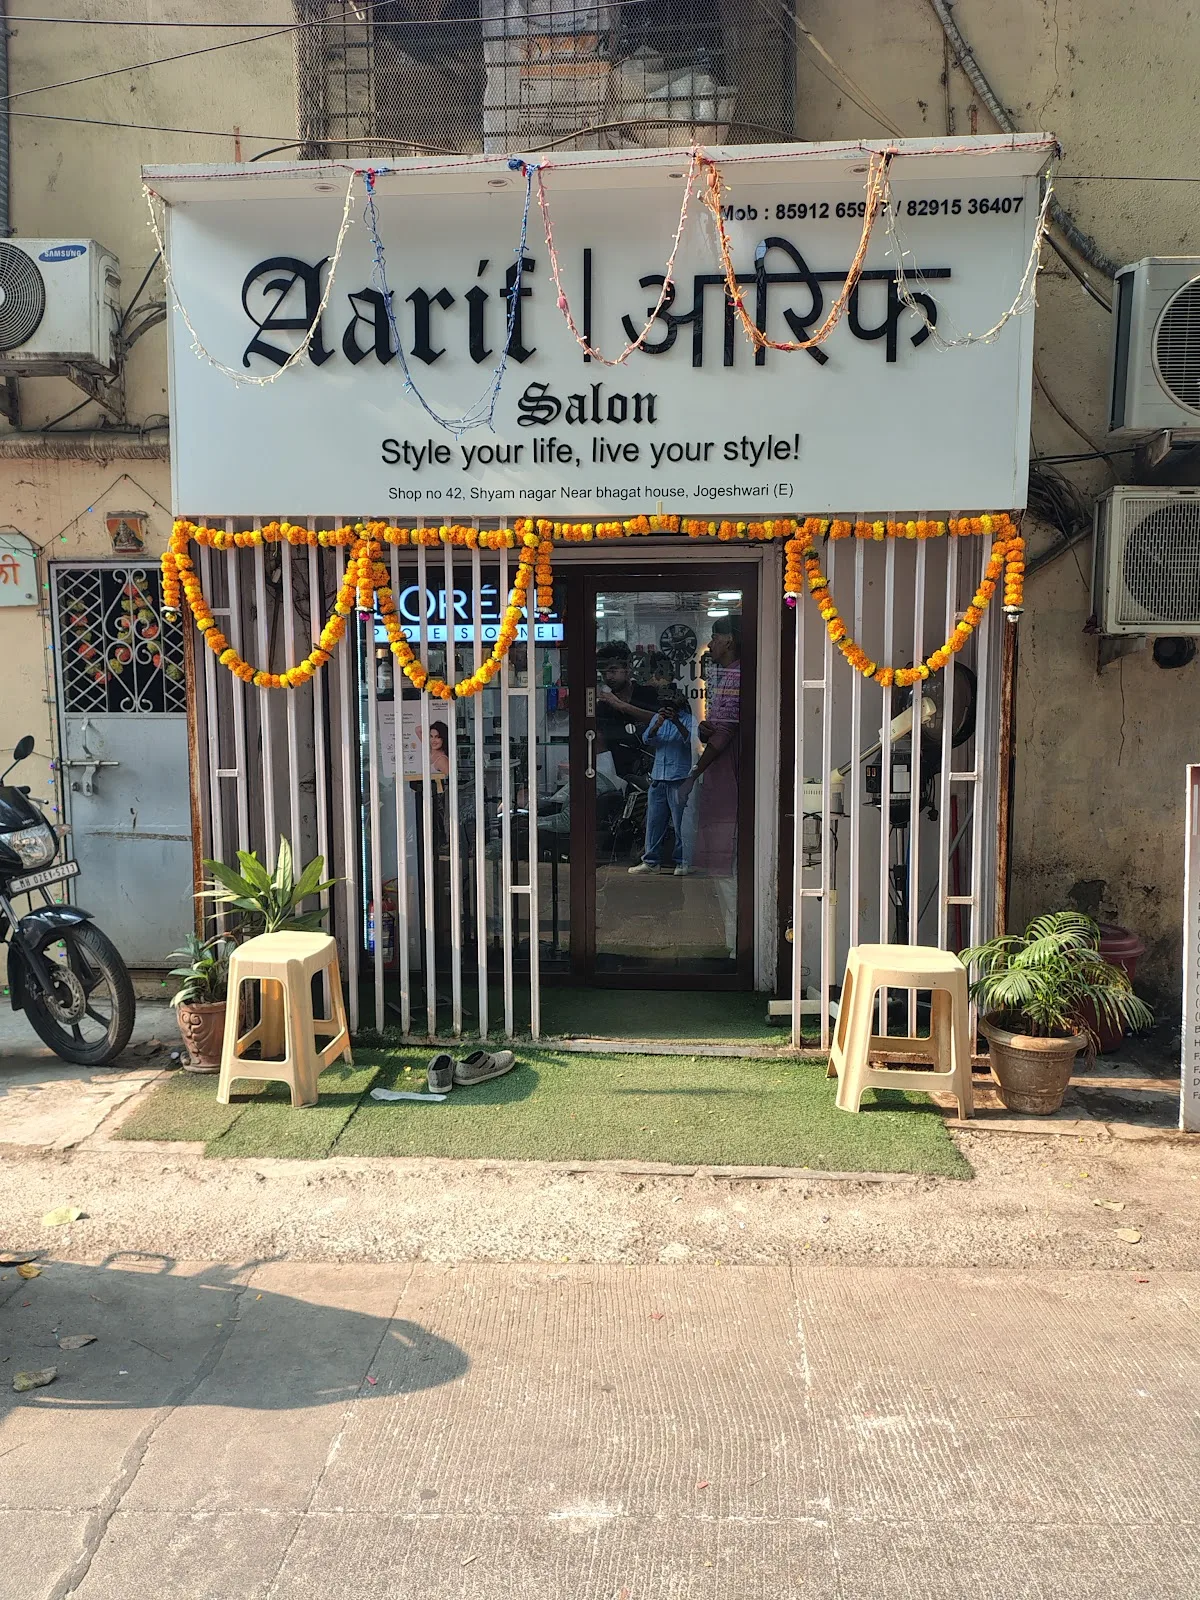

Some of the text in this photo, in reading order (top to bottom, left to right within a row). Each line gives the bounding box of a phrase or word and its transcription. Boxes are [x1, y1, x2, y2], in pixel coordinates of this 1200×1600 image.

[720, 204, 758, 221] Mob
[775, 202, 830, 220] 85912
[906, 199, 962, 216] 82915
[967, 196, 1024, 214] 36407
[44, 250, 82, 258] SAMSUNG
[241, 255, 537, 368] Aarif
[621, 236, 952, 367] आरिफ
[516, 381, 658, 426] Salon
[381, 433, 800, 471] Style your life, live your style!
[388, 483, 794, 502] Shop no 42, Shyam nagar Near bhagat house, Jogeshwari (E)
